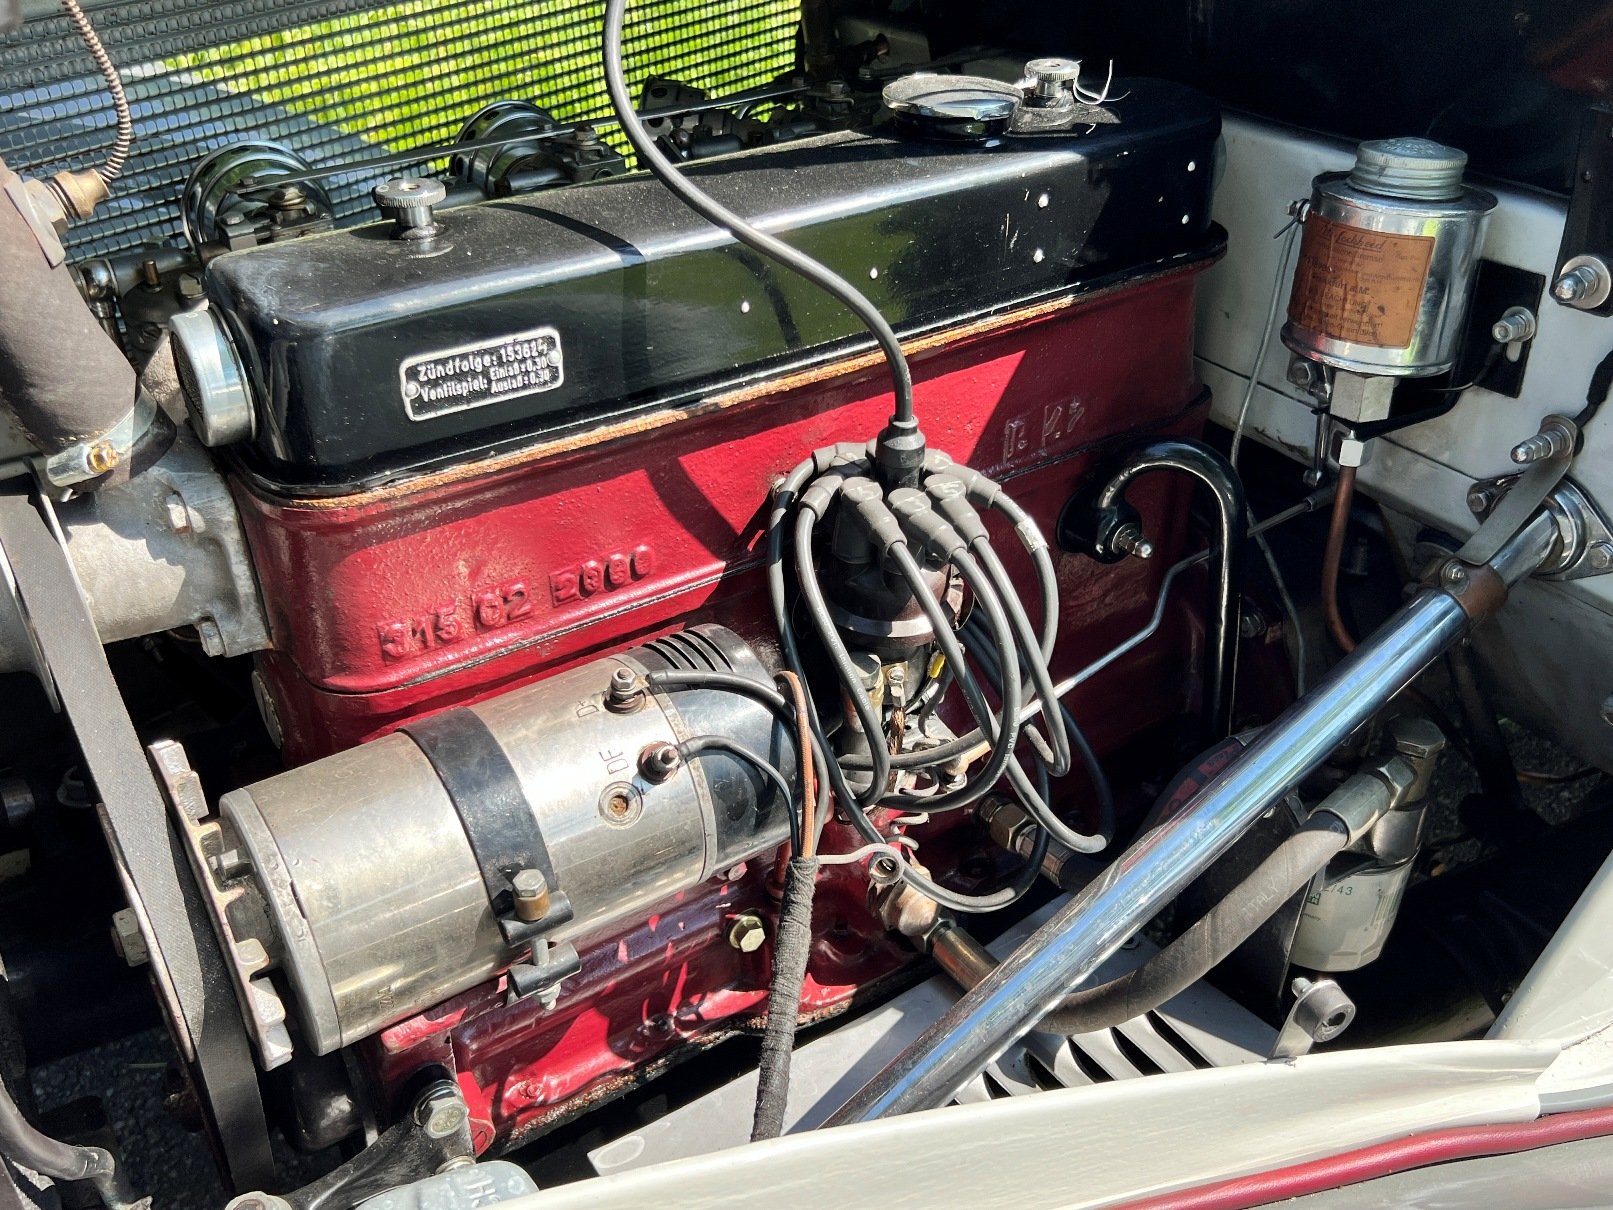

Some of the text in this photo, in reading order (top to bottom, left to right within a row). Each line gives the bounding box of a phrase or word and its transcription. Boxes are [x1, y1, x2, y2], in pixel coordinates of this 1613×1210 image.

[417, 339, 547, 382] Zündfolge: 153624
[420, 377, 488, 403] Ventilspiel:
[599, 749, 629, 775] DF
